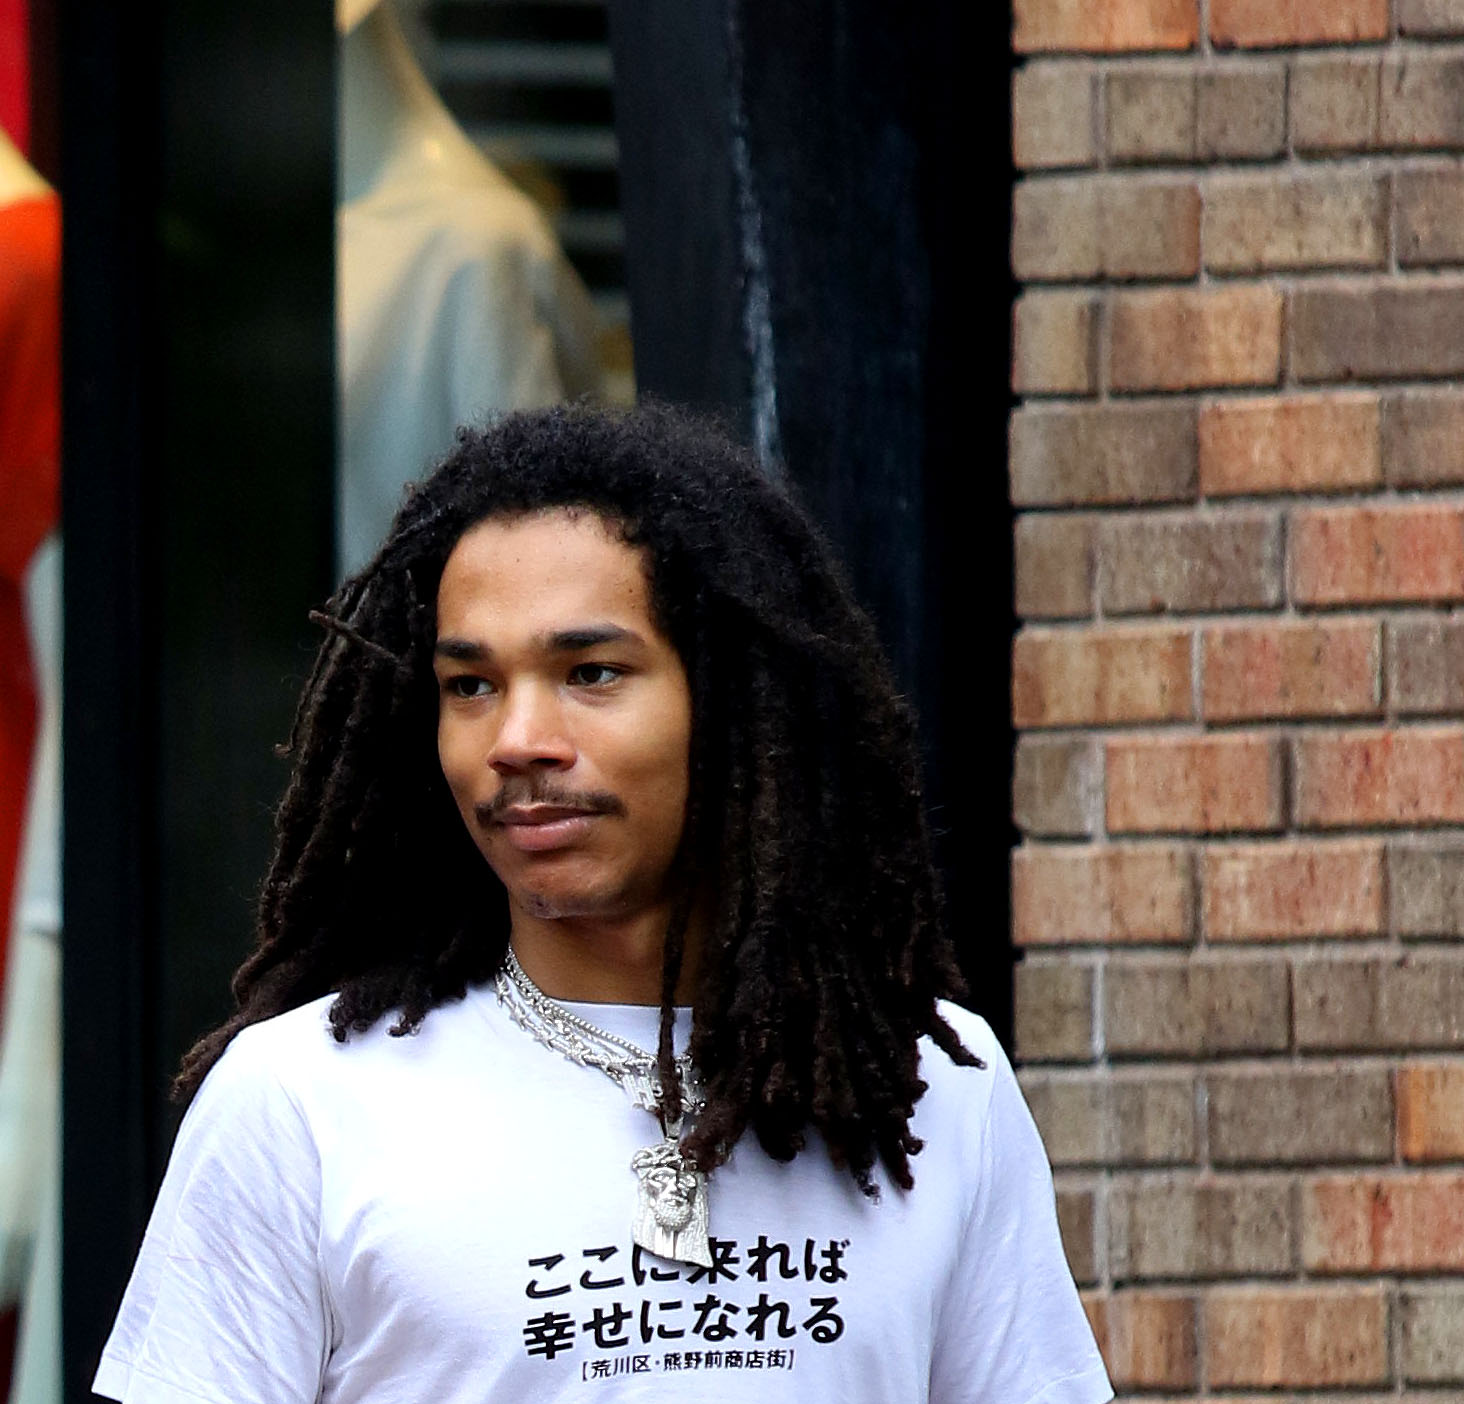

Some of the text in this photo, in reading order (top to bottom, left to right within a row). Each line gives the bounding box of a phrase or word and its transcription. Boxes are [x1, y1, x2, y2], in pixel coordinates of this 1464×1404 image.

[522, 1293, 845, 1360] 幸せになれる
